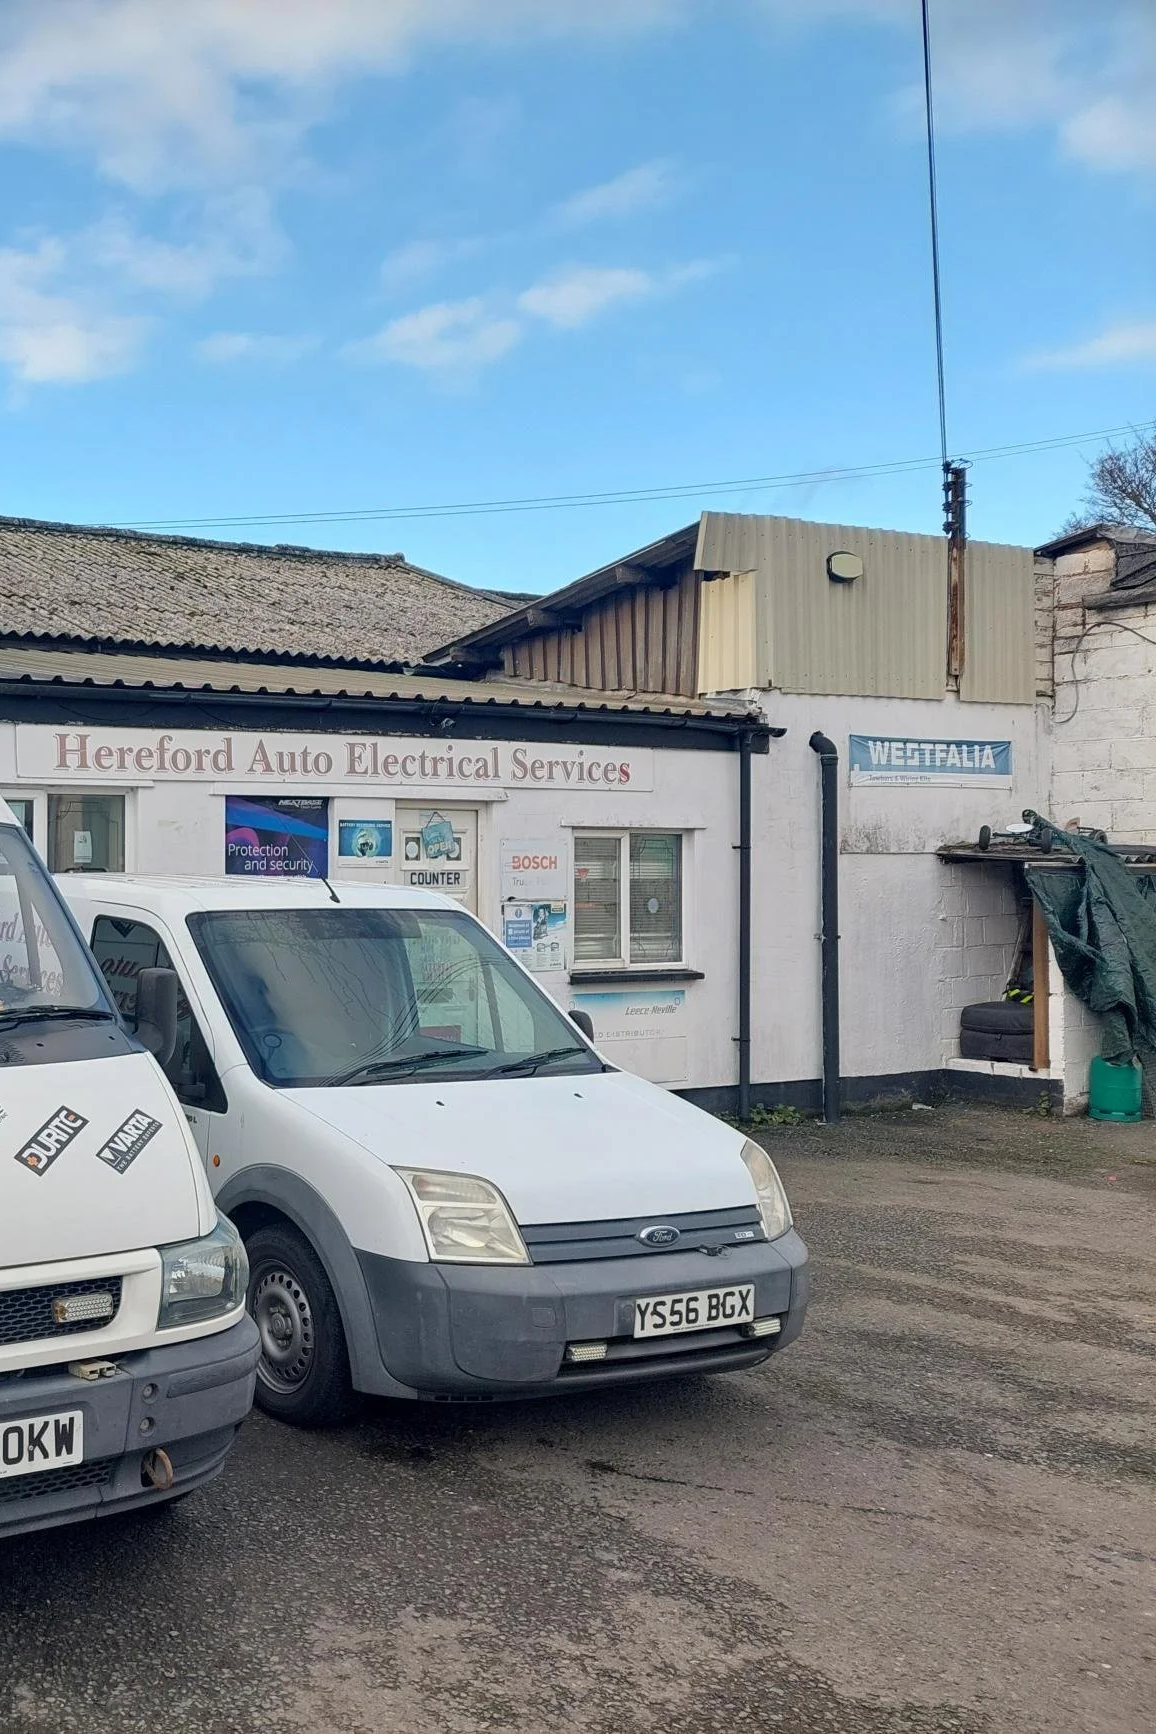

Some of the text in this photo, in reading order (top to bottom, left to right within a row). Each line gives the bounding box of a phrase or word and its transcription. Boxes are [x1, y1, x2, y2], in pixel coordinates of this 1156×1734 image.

[53, 733, 631, 785] Hereford Auto Electrical Services
[868, 740, 996, 769] WESTFALIA
[228, 843, 289, 856] Protection
[244, 858, 313, 874] and security
[512, 855, 558, 870] BOSCH
[410, 872, 460, 886] COUNTER
[625, 1004, 677, 1016] Leece Neville
[109, 1112, 153, 1152] VARTA
[652, 1230, 673, 1242] Ford
[637, 1288, 751, 1331] YS56 BGX
[2, 1416, 75, 1466] OKW
